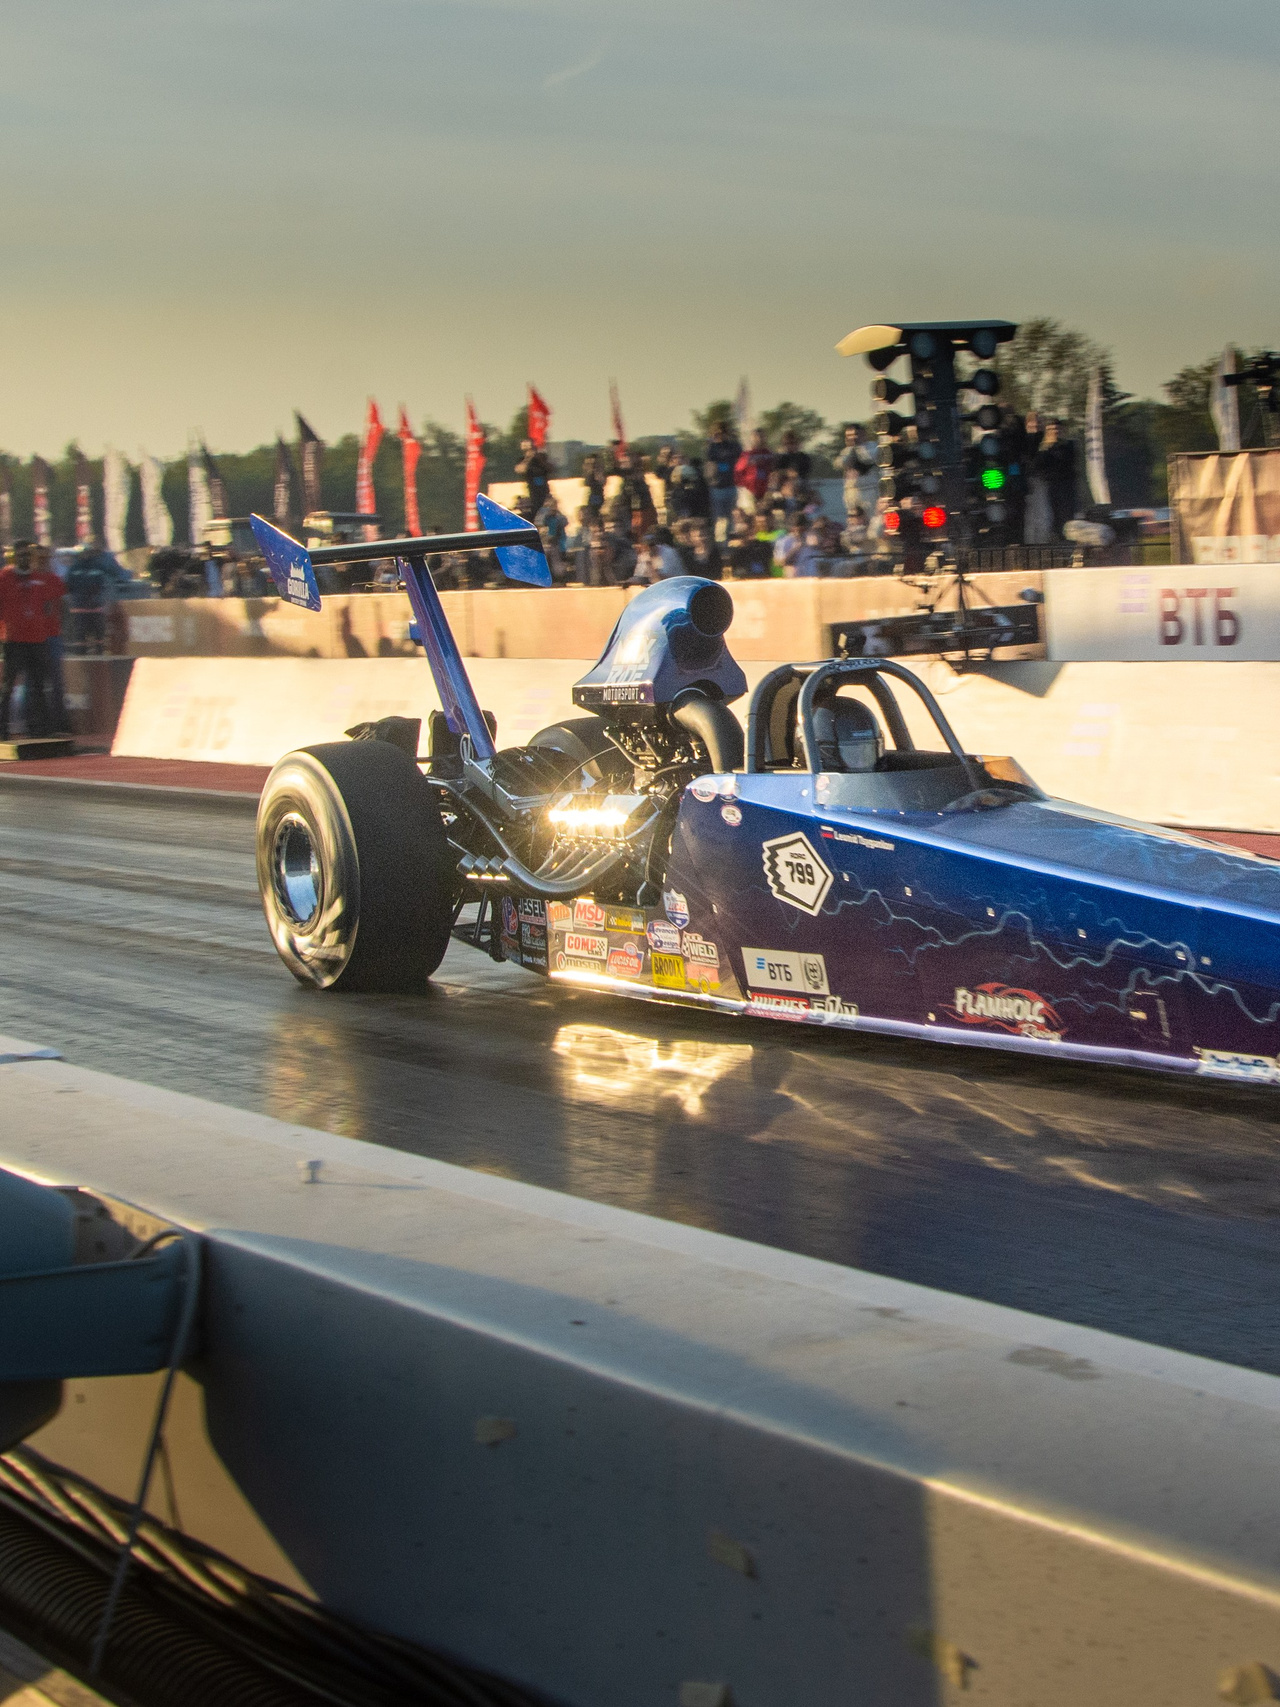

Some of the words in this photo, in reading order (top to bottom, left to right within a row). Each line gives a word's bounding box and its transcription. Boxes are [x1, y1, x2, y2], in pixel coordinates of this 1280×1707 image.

[288, 578, 310, 600] GORILLA
[1157, 587, 1242, 646] ВТБ
[603, 688, 639, 700] MOTORSPORT
[785, 860, 816, 886] 799
[519, 897, 546, 918] JESEL
[575, 902, 605, 922] MSD
[567, 935, 597, 952] COMP
[689, 943, 716, 958] WELD
[610, 955, 629, 966] LUCAS
[629, 958, 639, 967] OIL
[654, 957, 684, 978] BRODIX
[768, 963, 793, 982] ВТБ
